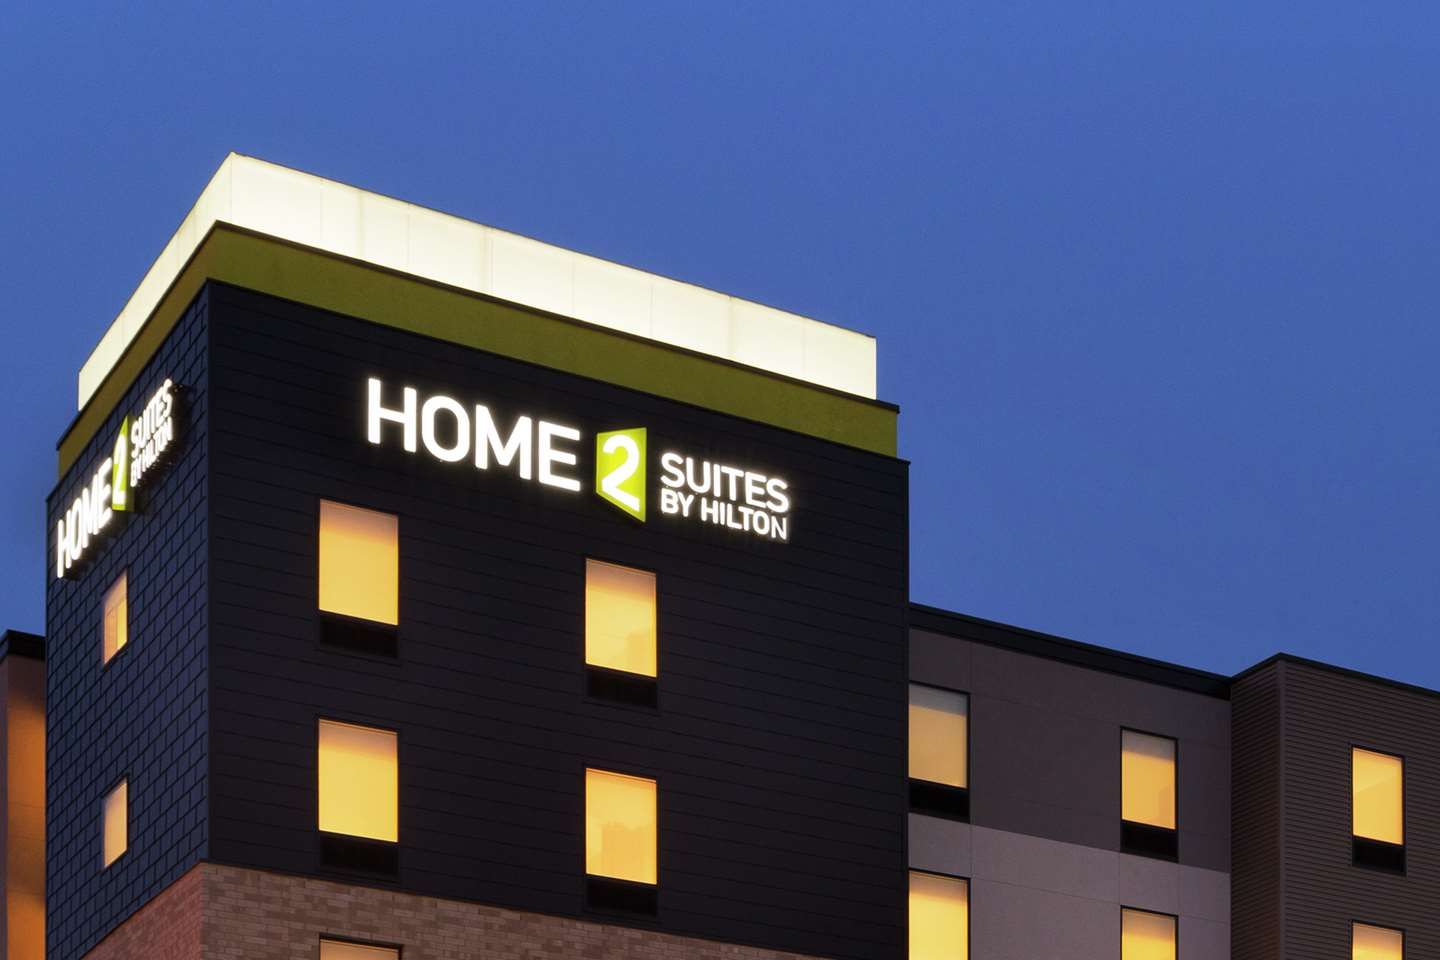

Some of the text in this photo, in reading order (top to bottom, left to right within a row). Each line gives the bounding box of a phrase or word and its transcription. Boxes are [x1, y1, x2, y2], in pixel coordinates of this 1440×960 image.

[130, 378, 173, 459] SUITES
[367, 376, 640, 513] HOME 2
[57, 434, 127, 578] HOME 2
[660, 452, 790, 514] SUITES
[661, 487, 788, 541] BY HILTON
